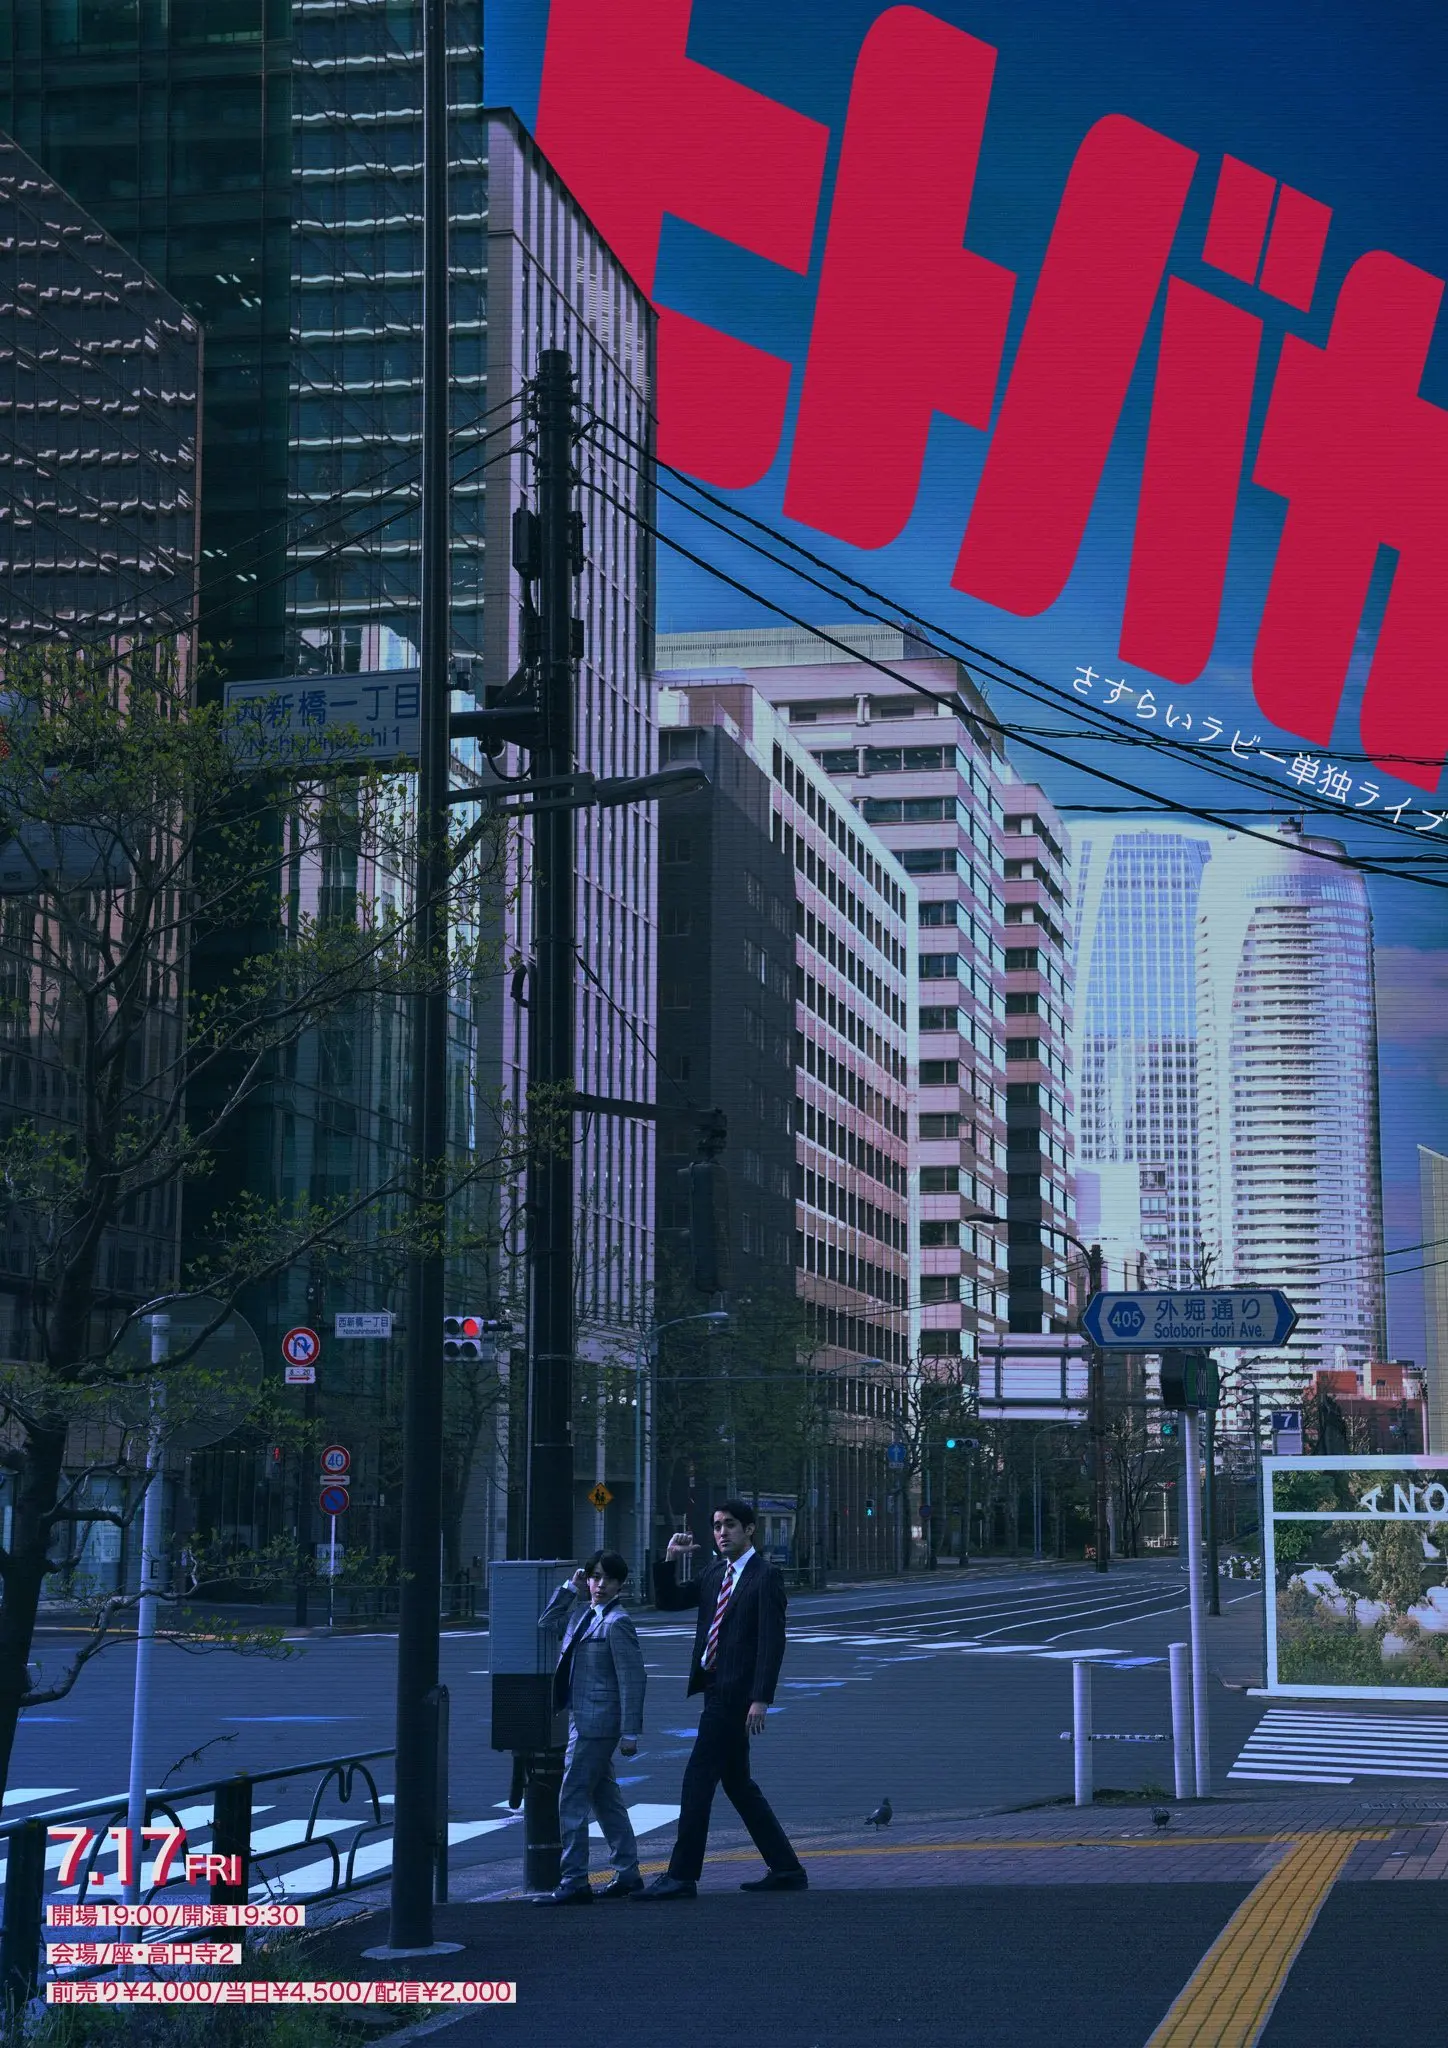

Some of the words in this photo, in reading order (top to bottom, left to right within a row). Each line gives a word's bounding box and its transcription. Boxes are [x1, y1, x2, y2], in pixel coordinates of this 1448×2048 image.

[1156, 1299, 1261, 1321] 外堀通り
[1111, 1310, 1142, 1329] 405
[1154, 1322, 1235, 1339] Sotobori-dori
[1239, 1323, 1265, 1338] Ave.
[1280, 1413, 1293, 1428] 7
[327, 1454, 344, 1468] 40
